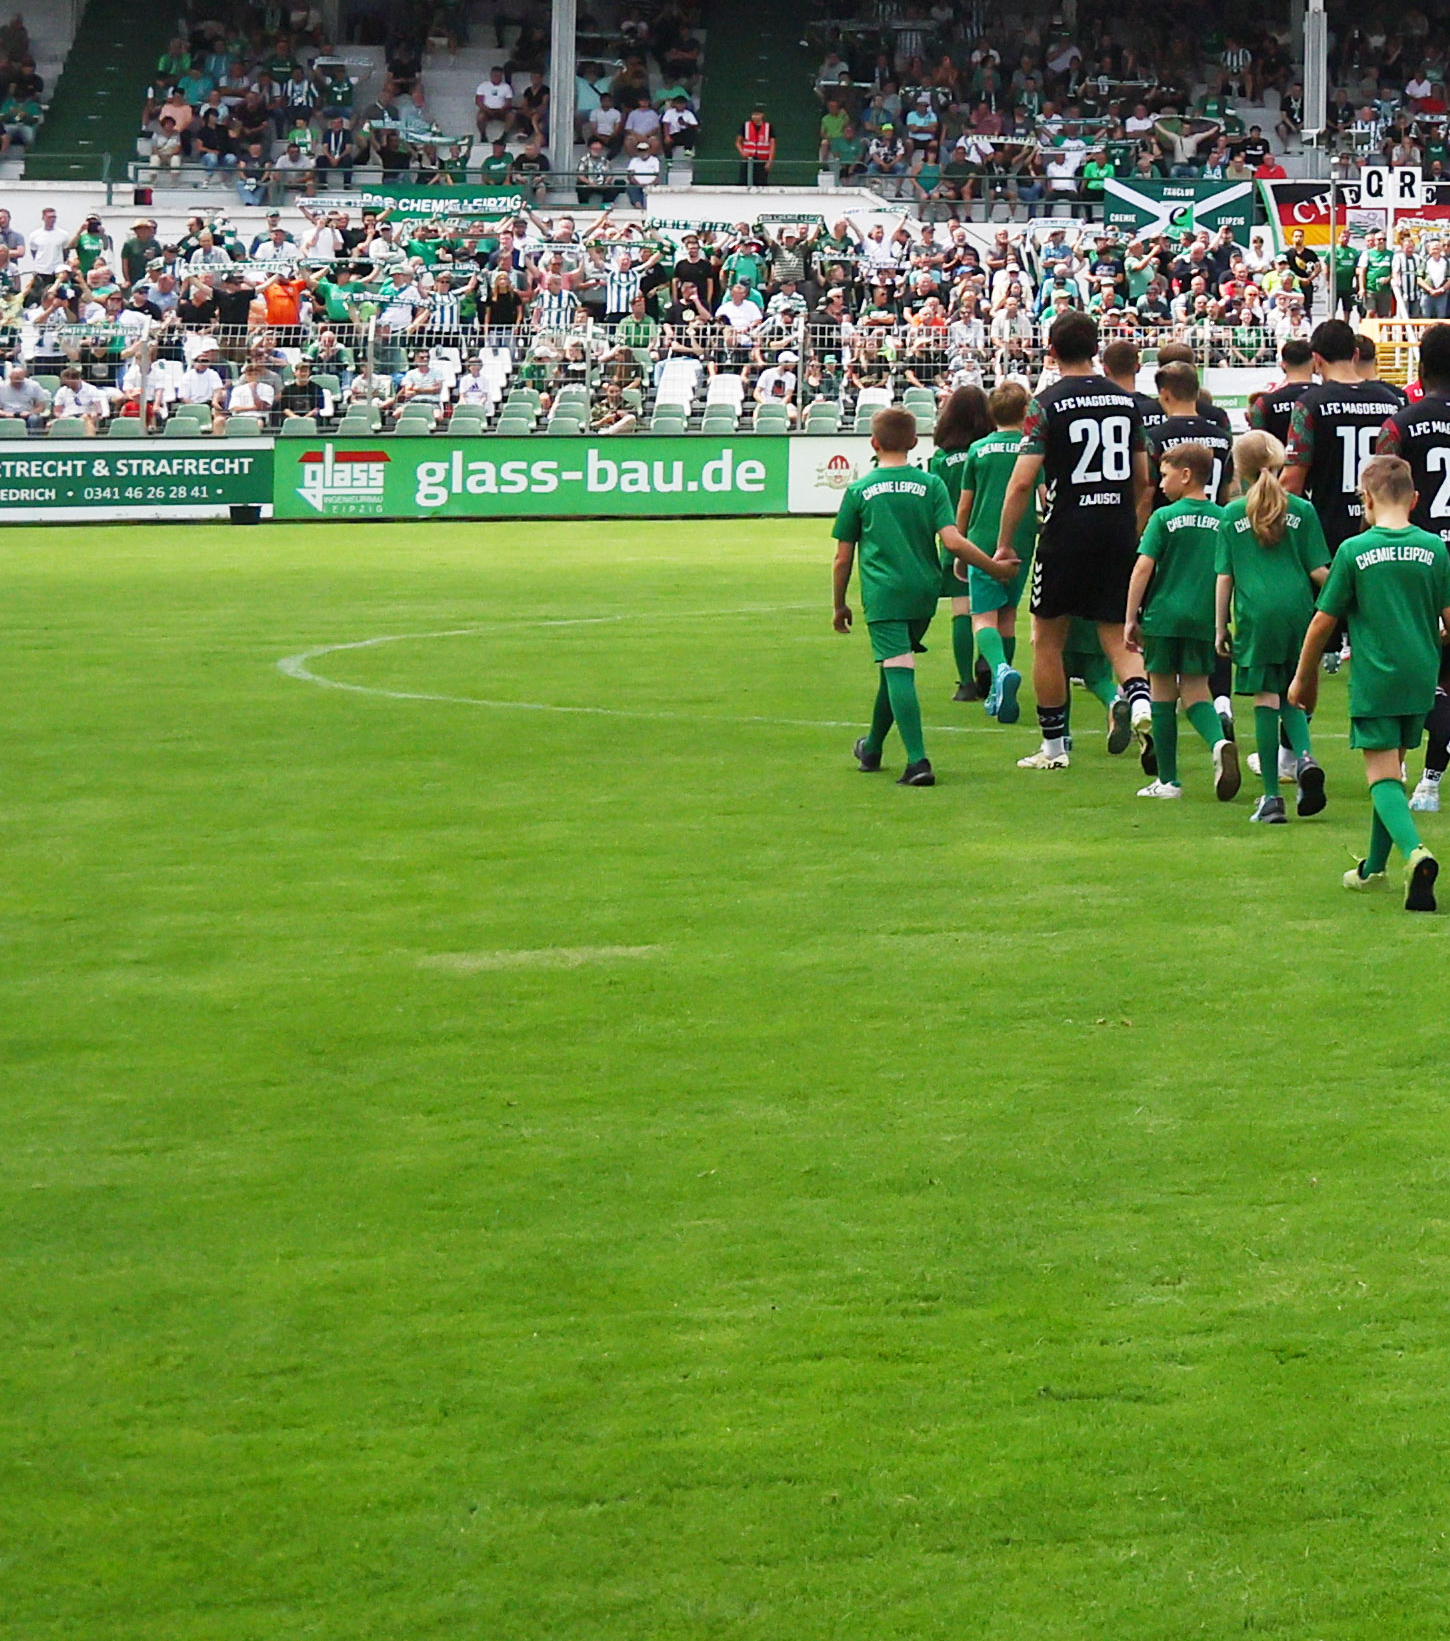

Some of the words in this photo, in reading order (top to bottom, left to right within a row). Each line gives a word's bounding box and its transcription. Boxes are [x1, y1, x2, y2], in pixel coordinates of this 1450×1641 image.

[1366, 170, 1384, 198] Q
[1400, 169, 1416, 198] R
[1217, 216, 1246, 226] LEIPZIG
[1054, 396, 1076, 413] 1.FC
[1077, 394, 1135, 410] MAGDEBURG
[1319, 402, 1341, 417] 1.FC
[1342, 401, 1399, 416] MAGDEBURG
[1408, 420, 1431, 438] 1.FC
[976, 443, 1004, 459] CHEMIE
[1068, 415, 1132, 485] 28
[92, 460, 110, 477] &
[116, 457, 254, 477] STRAFRECHT
[303, 442, 386, 489] glass
[415, 448, 766, 507] glass-bau.de
[84, 487, 120, 500] 0341
[125, 487, 143, 500] 46
[147, 487, 165, 499] 26
[169, 487, 187, 499] 28
[190, 486, 209, 499] 41
[862, 480, 894, 501] CHEMIE
[895, 479, 927, 497] LEIPZIG
[1079, 492, 1122, 507] ZAJUSCH
[1166, 515, 1197, 533] CHEMIE
[1355, 546, 1397, 571] CHEMIE
[1397, 545, 1435, 566] LEIPZIG
